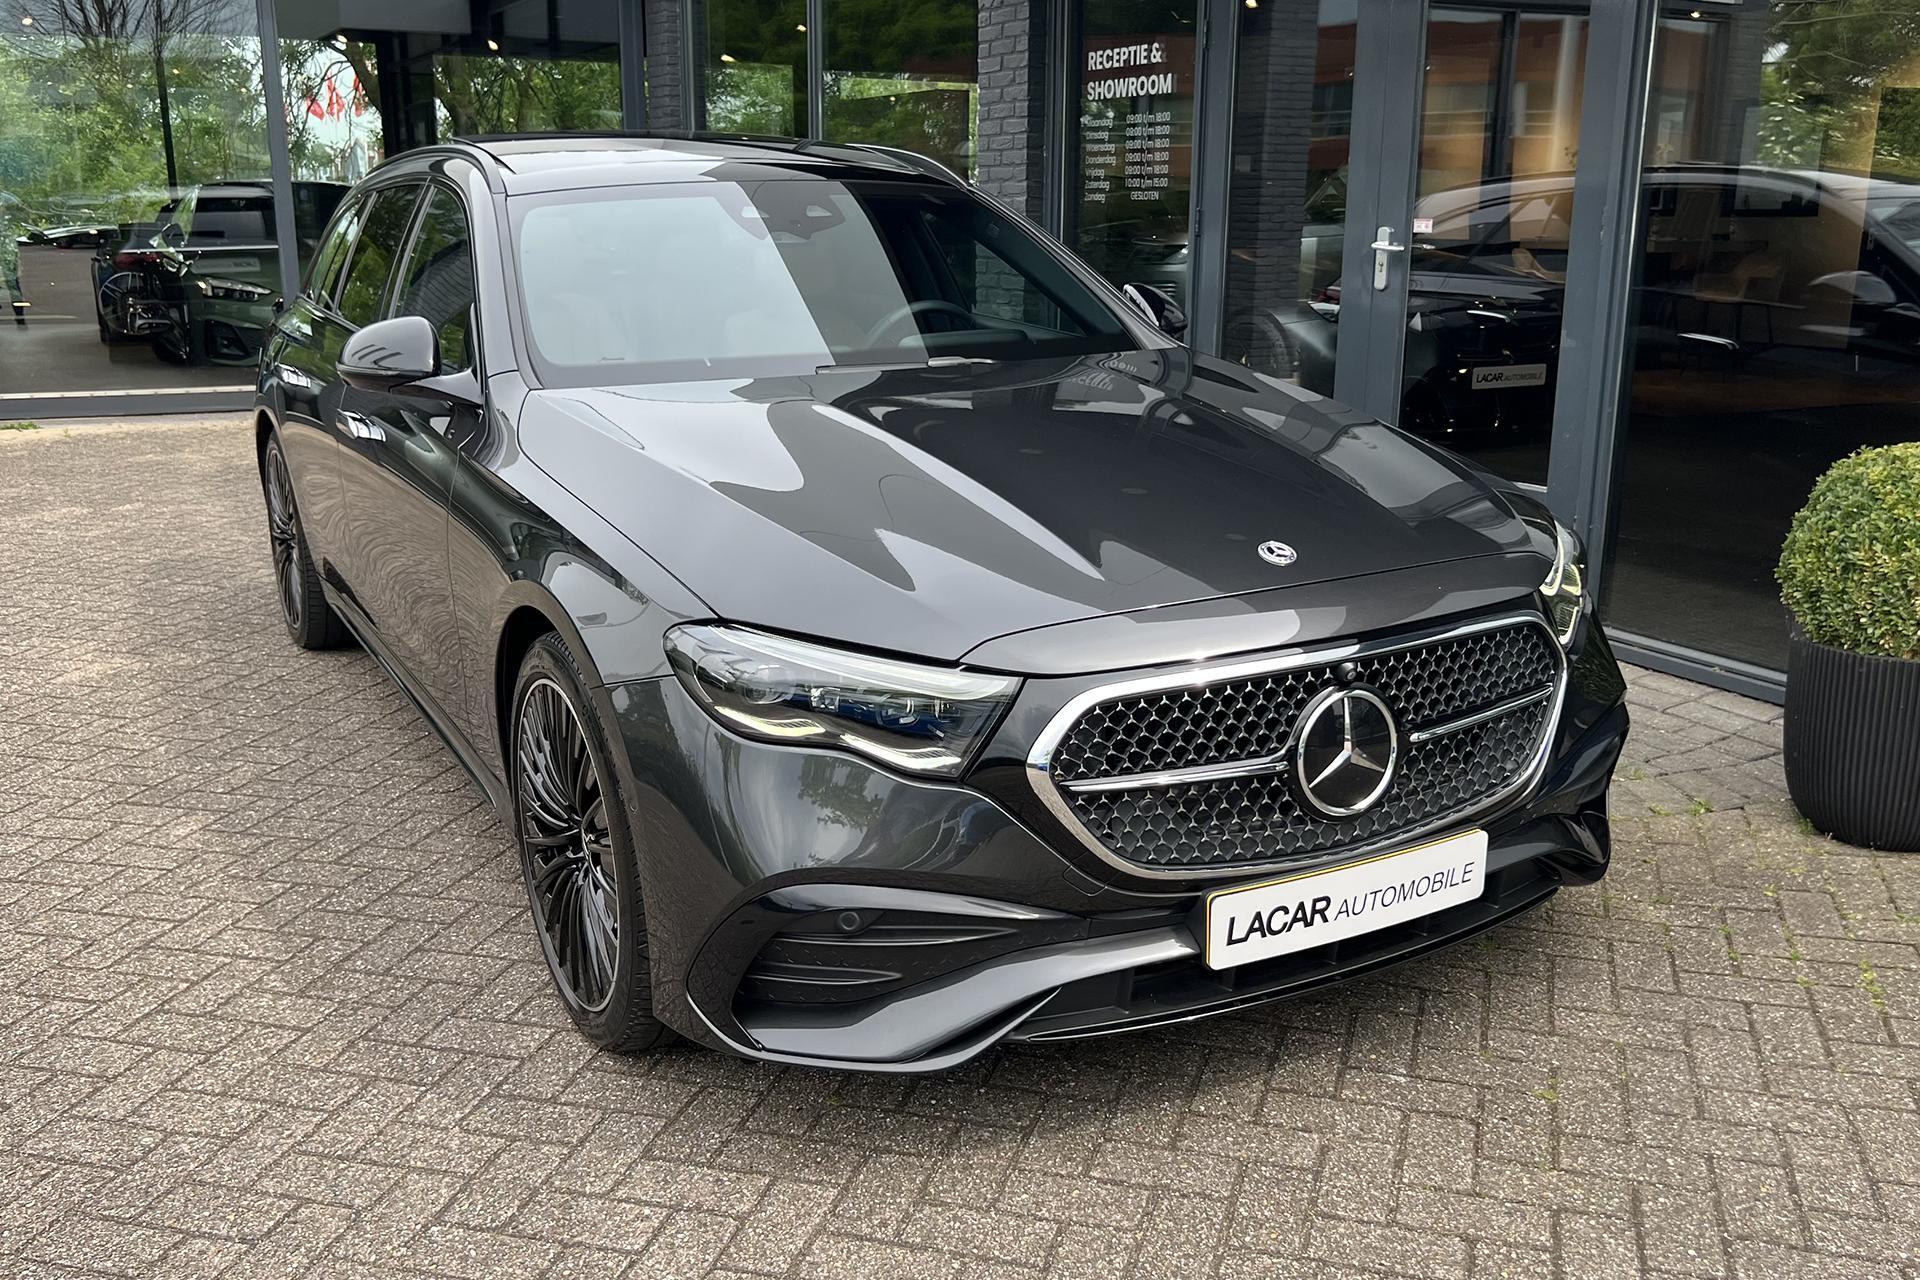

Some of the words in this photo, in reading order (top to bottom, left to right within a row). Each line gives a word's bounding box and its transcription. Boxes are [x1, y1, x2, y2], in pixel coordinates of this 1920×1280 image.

[1088, 44, 1148, 71] RECEPTIE
[1150, 42, 1162, 64] &
[1087, 73, 1172, 101] SHOWROOM
[1131, 191, 1159, 200] GESLOTEN
[1476, 372, 1503, 383] LACAR
[1226, 895, 1331, 947] LACAR
[1334, 861, 1475, 922] AUTOMOBILE
